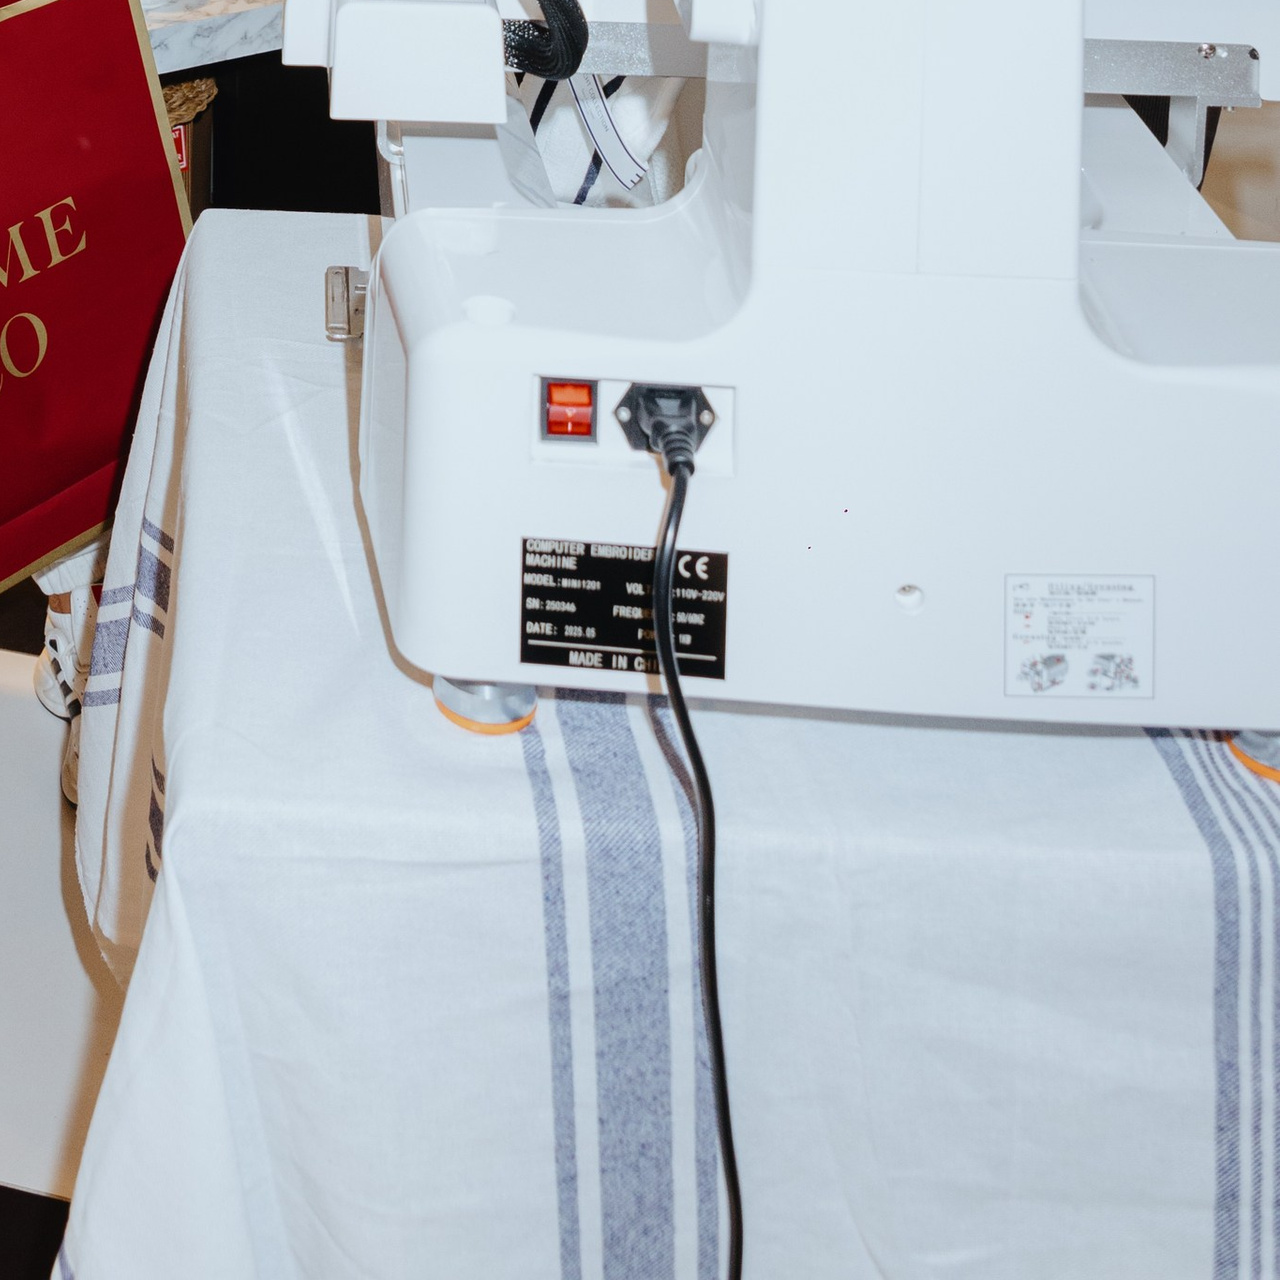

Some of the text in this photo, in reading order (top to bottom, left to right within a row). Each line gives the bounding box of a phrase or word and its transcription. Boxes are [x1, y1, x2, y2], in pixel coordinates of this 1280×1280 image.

[588, 88, 609, 132] COLLECTION
[526, 539, 585, 555] COMPUTER
[525, 553, 577, 570] MACHINE
[526, 621, 558, 636] DATE:
[569, 650, 603, 667] MADE
[612, 654, 627, 671] IN
